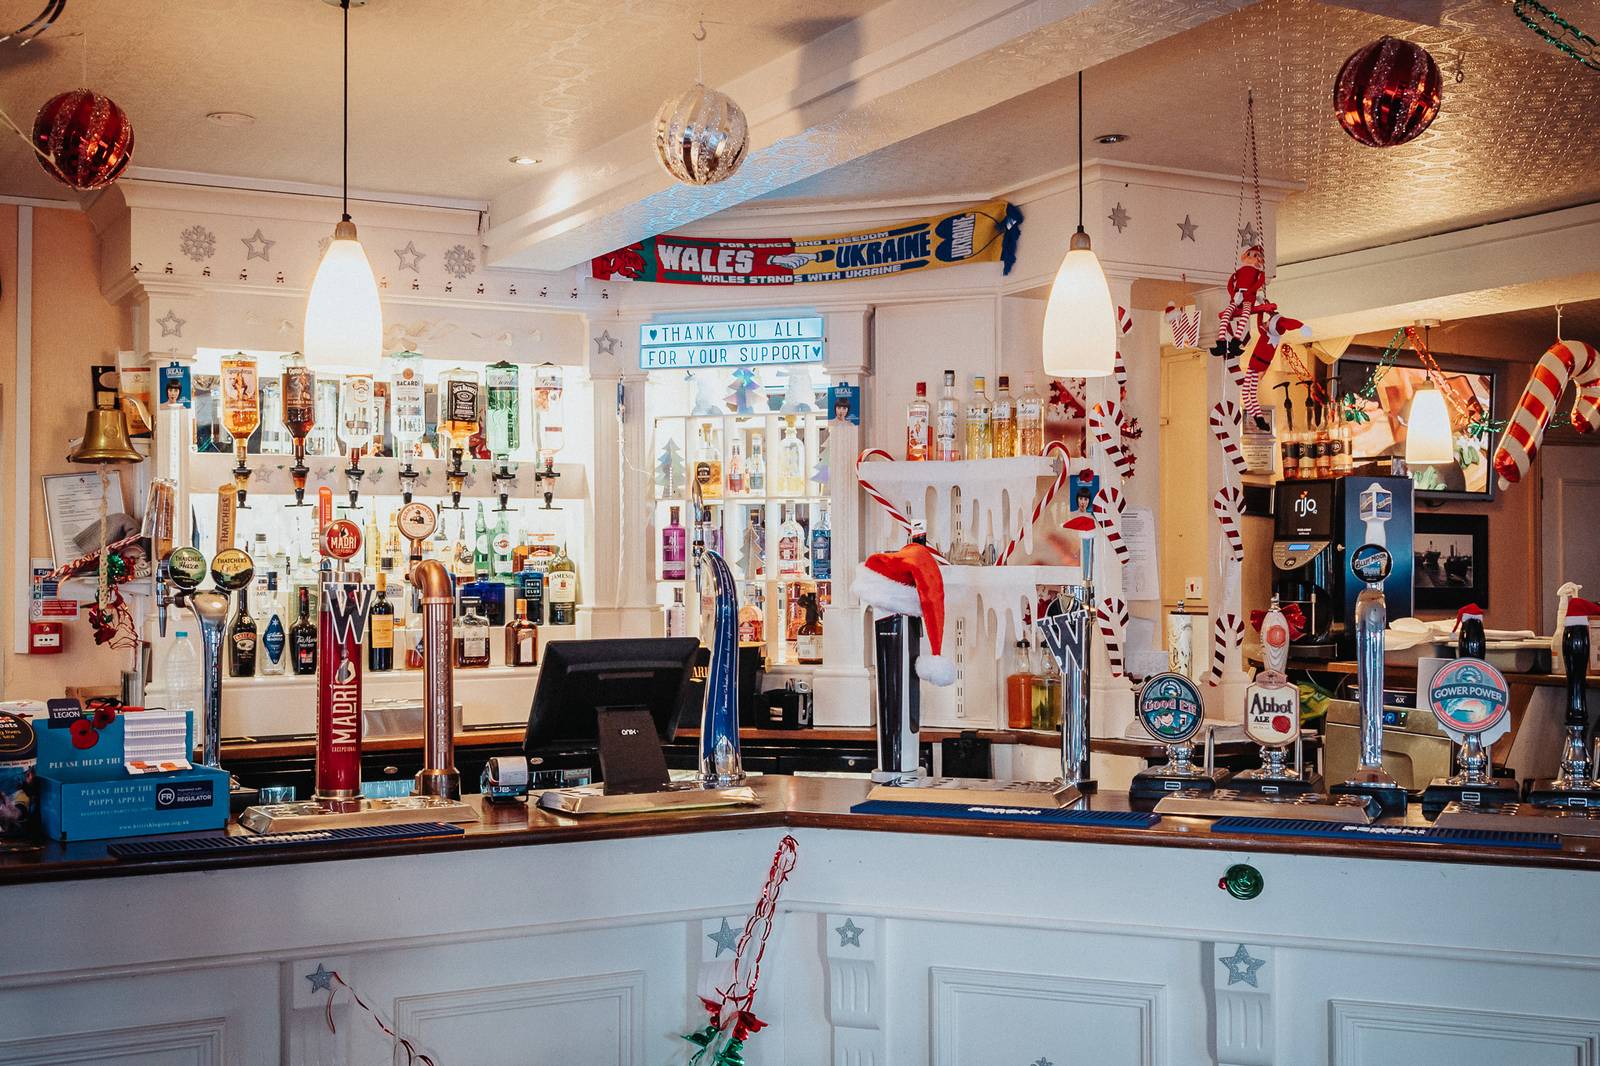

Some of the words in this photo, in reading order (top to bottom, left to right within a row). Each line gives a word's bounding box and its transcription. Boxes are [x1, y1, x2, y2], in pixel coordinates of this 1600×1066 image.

[826, 231, 889, 244] FREEDOM
[951, 212, 976, 258] UKRAINE
[657, 244, 755, 274] WALES
[836, 230, 931, 269] UKRAINE
[701, 274, 745, 284] WALES
[749, 274, 803, 284] STANDS
[807, 272, 841, 282] WITH
[846, 264, 902, 279] UKRAINE
[662, 325, 715, 342] THANK
[728, 323, 758, 339] YOU
[774, 321, 803, 337] ALL
[648, 350, 677, 366] FOR
[688, 348, 727, 364] YOUR
[739, 344, 810, 362] SUPPORT
[1294, 492, 1316, 517] rijo
[221, 496, 231, 542] THATCHERS
[323, 581, 376, 645] W
[1036, 610, 1089, 674] W
[1249, 692, 1294, 714] Abbot
[1434, 687, 1469, 699] GOWER
[1469, 687, 1503, 702] POWER
[53, 711, 80, 719] LEGION
[1254, 715, 1270, 723] ALE
[49, 761, 79, 769] PLEASE
[82, 759, 105, 767] HELP
[106, 757, 121, 765] THE
[81, 788, 110, 797] PLEASE
[114, 786, 135, 794] HELP
[88, 799, 114, 807] POPPY
[118, 797, 145, 805] APPEAL
[177, 794, 212, 802] REGULATOR
